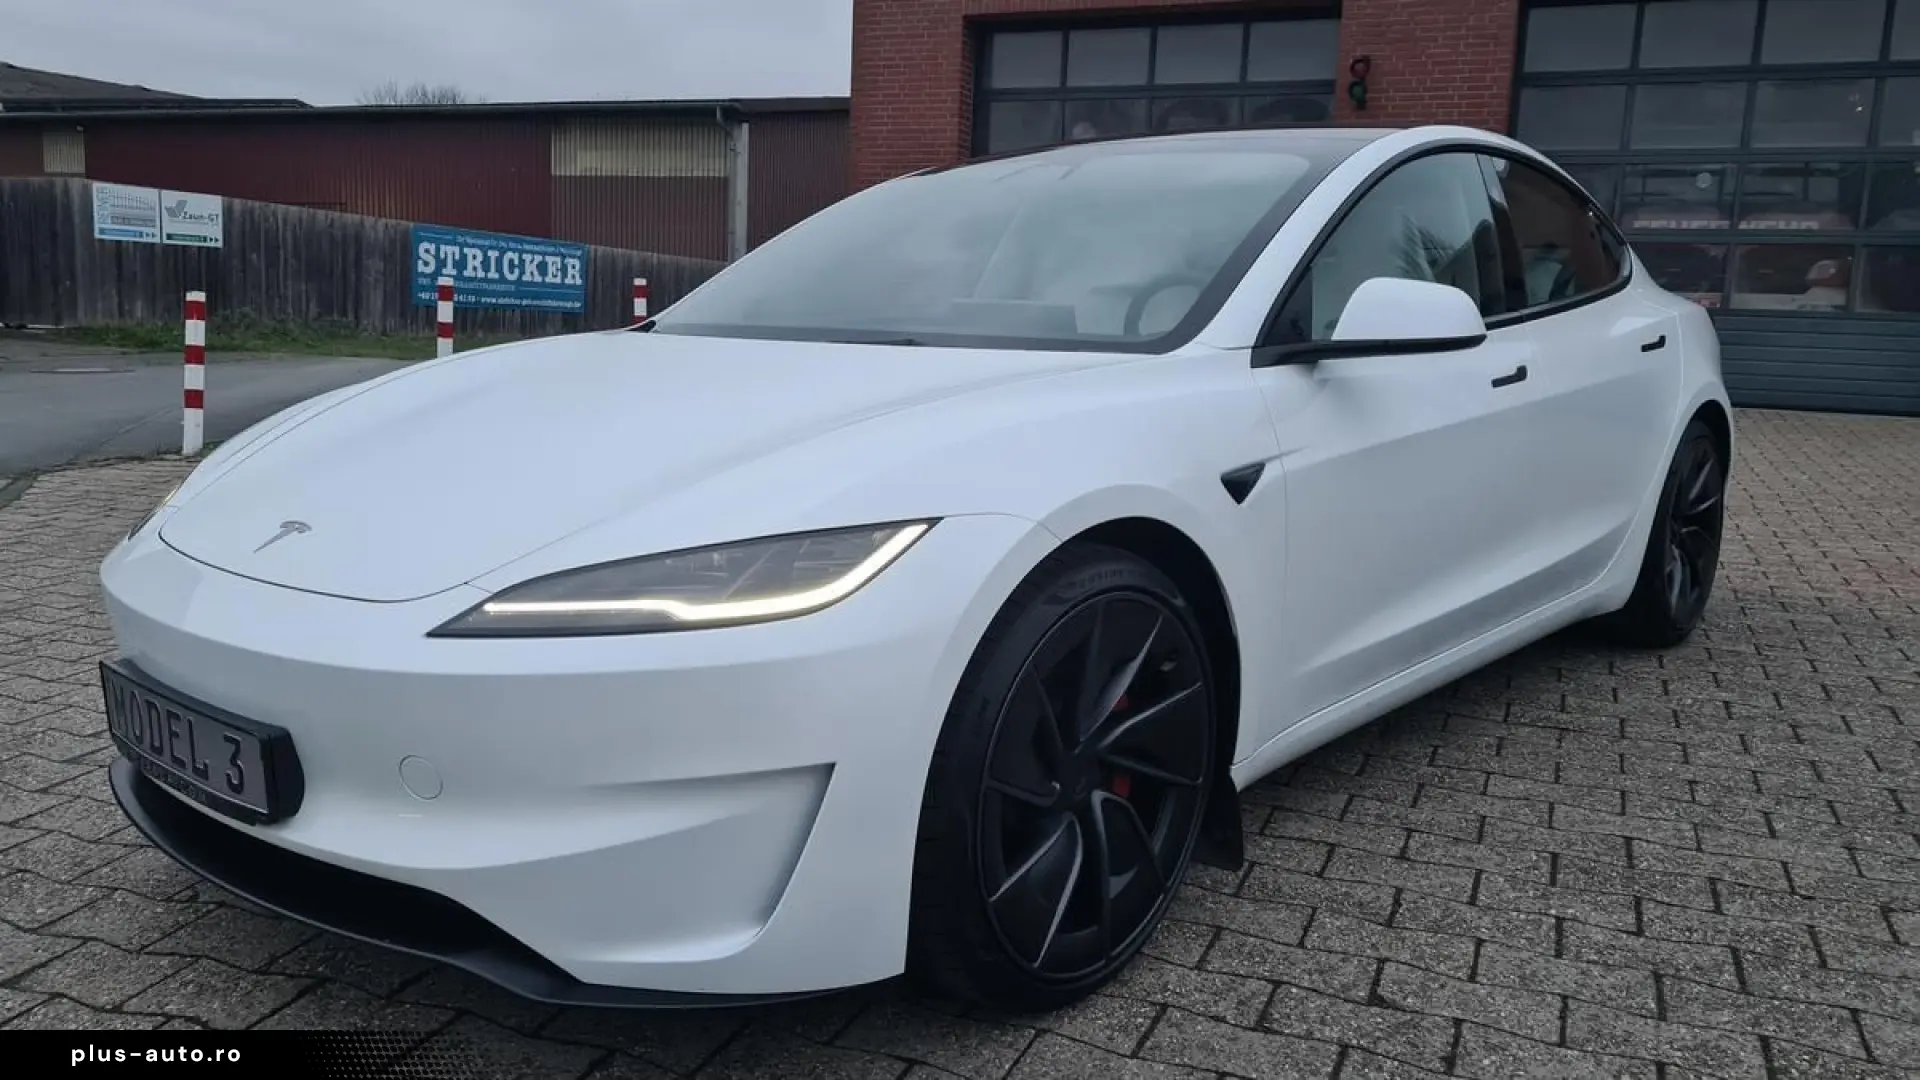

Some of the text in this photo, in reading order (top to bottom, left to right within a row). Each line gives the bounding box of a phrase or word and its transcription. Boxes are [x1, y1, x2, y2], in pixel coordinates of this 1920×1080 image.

[417, 241, 582, 285] STRICKER
[105, 675, 209, 781] MODEL
[223, 732, 244, 795] 3
